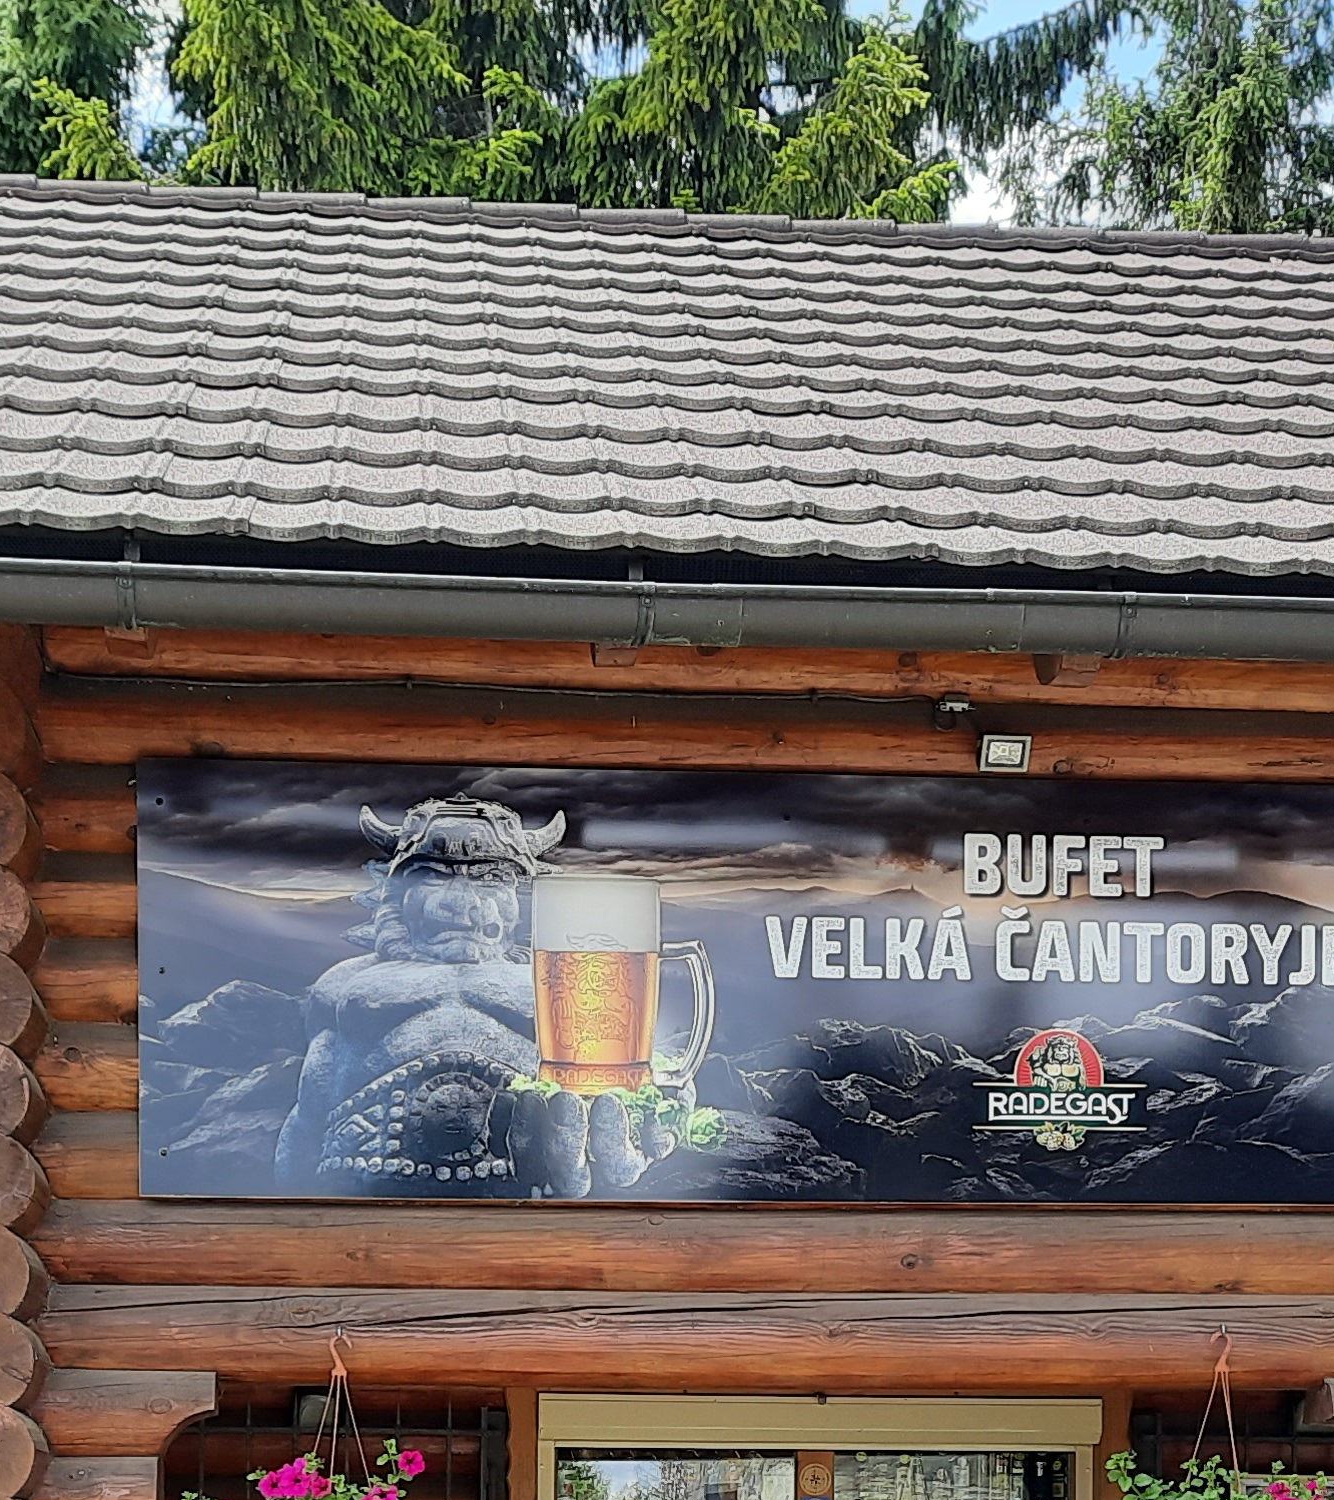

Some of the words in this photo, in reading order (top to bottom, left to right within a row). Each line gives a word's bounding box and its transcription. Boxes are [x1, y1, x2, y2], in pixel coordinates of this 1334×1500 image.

[964, 832, 1166, 897] BUFET
[766, 905, 972, 982] VELKÁ
[552, 1068, 641, 1092] RADEGAST
[988, 1091, 1136, 1125] RADEGAST
